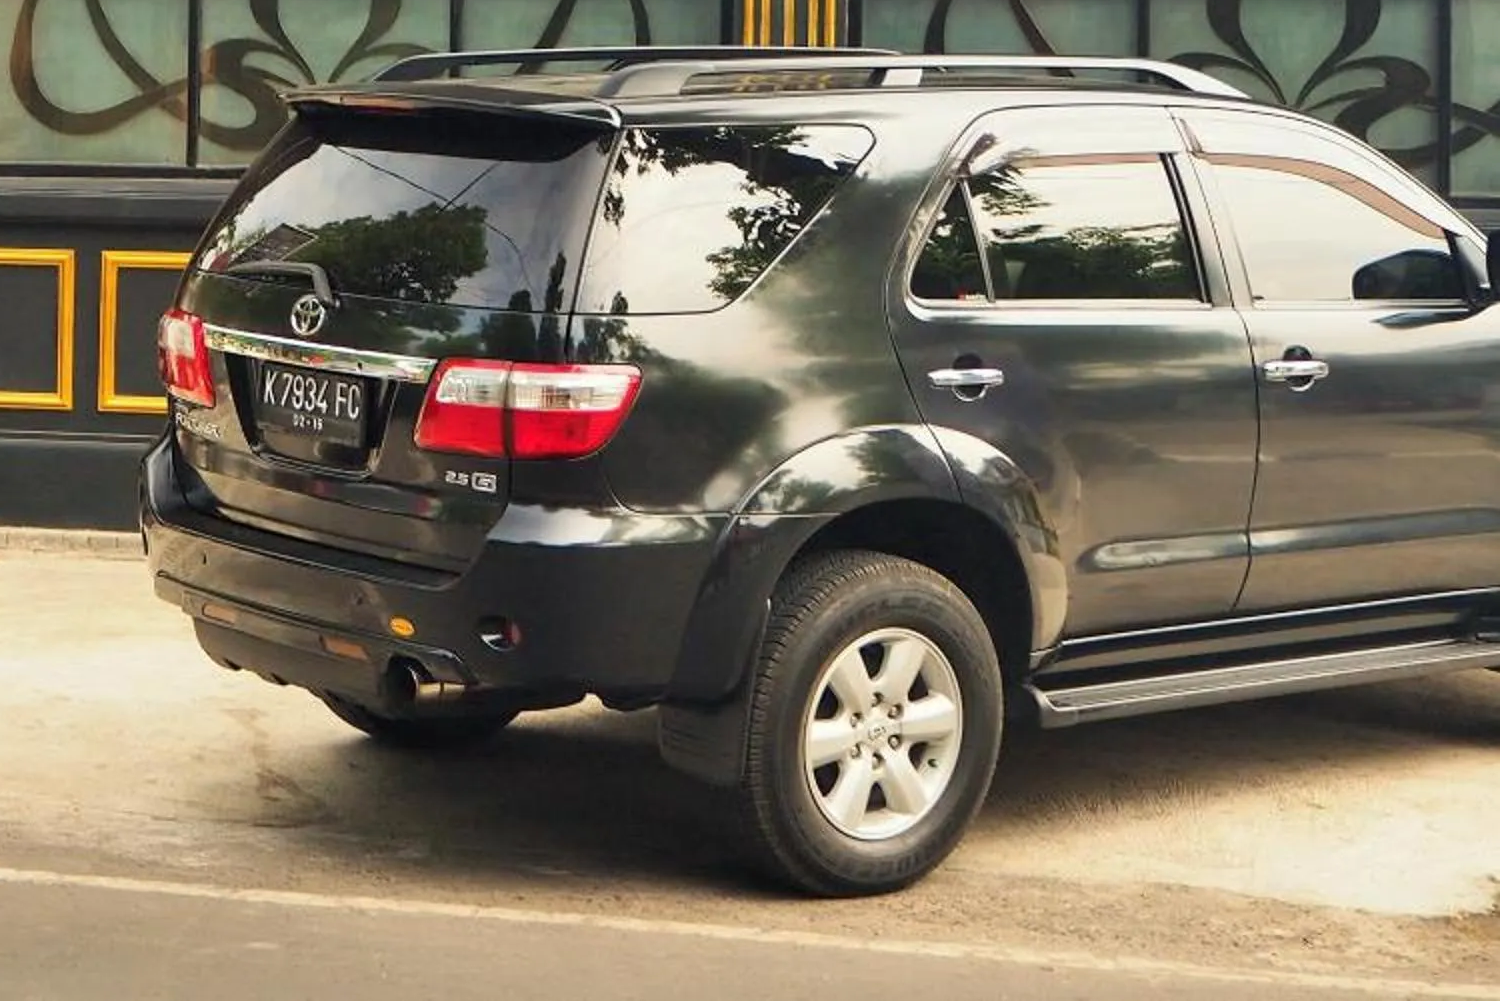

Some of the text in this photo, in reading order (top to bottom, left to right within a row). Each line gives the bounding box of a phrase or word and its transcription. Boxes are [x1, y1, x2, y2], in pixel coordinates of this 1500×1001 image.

[263, 370, 361, 420] K 7934 FC
